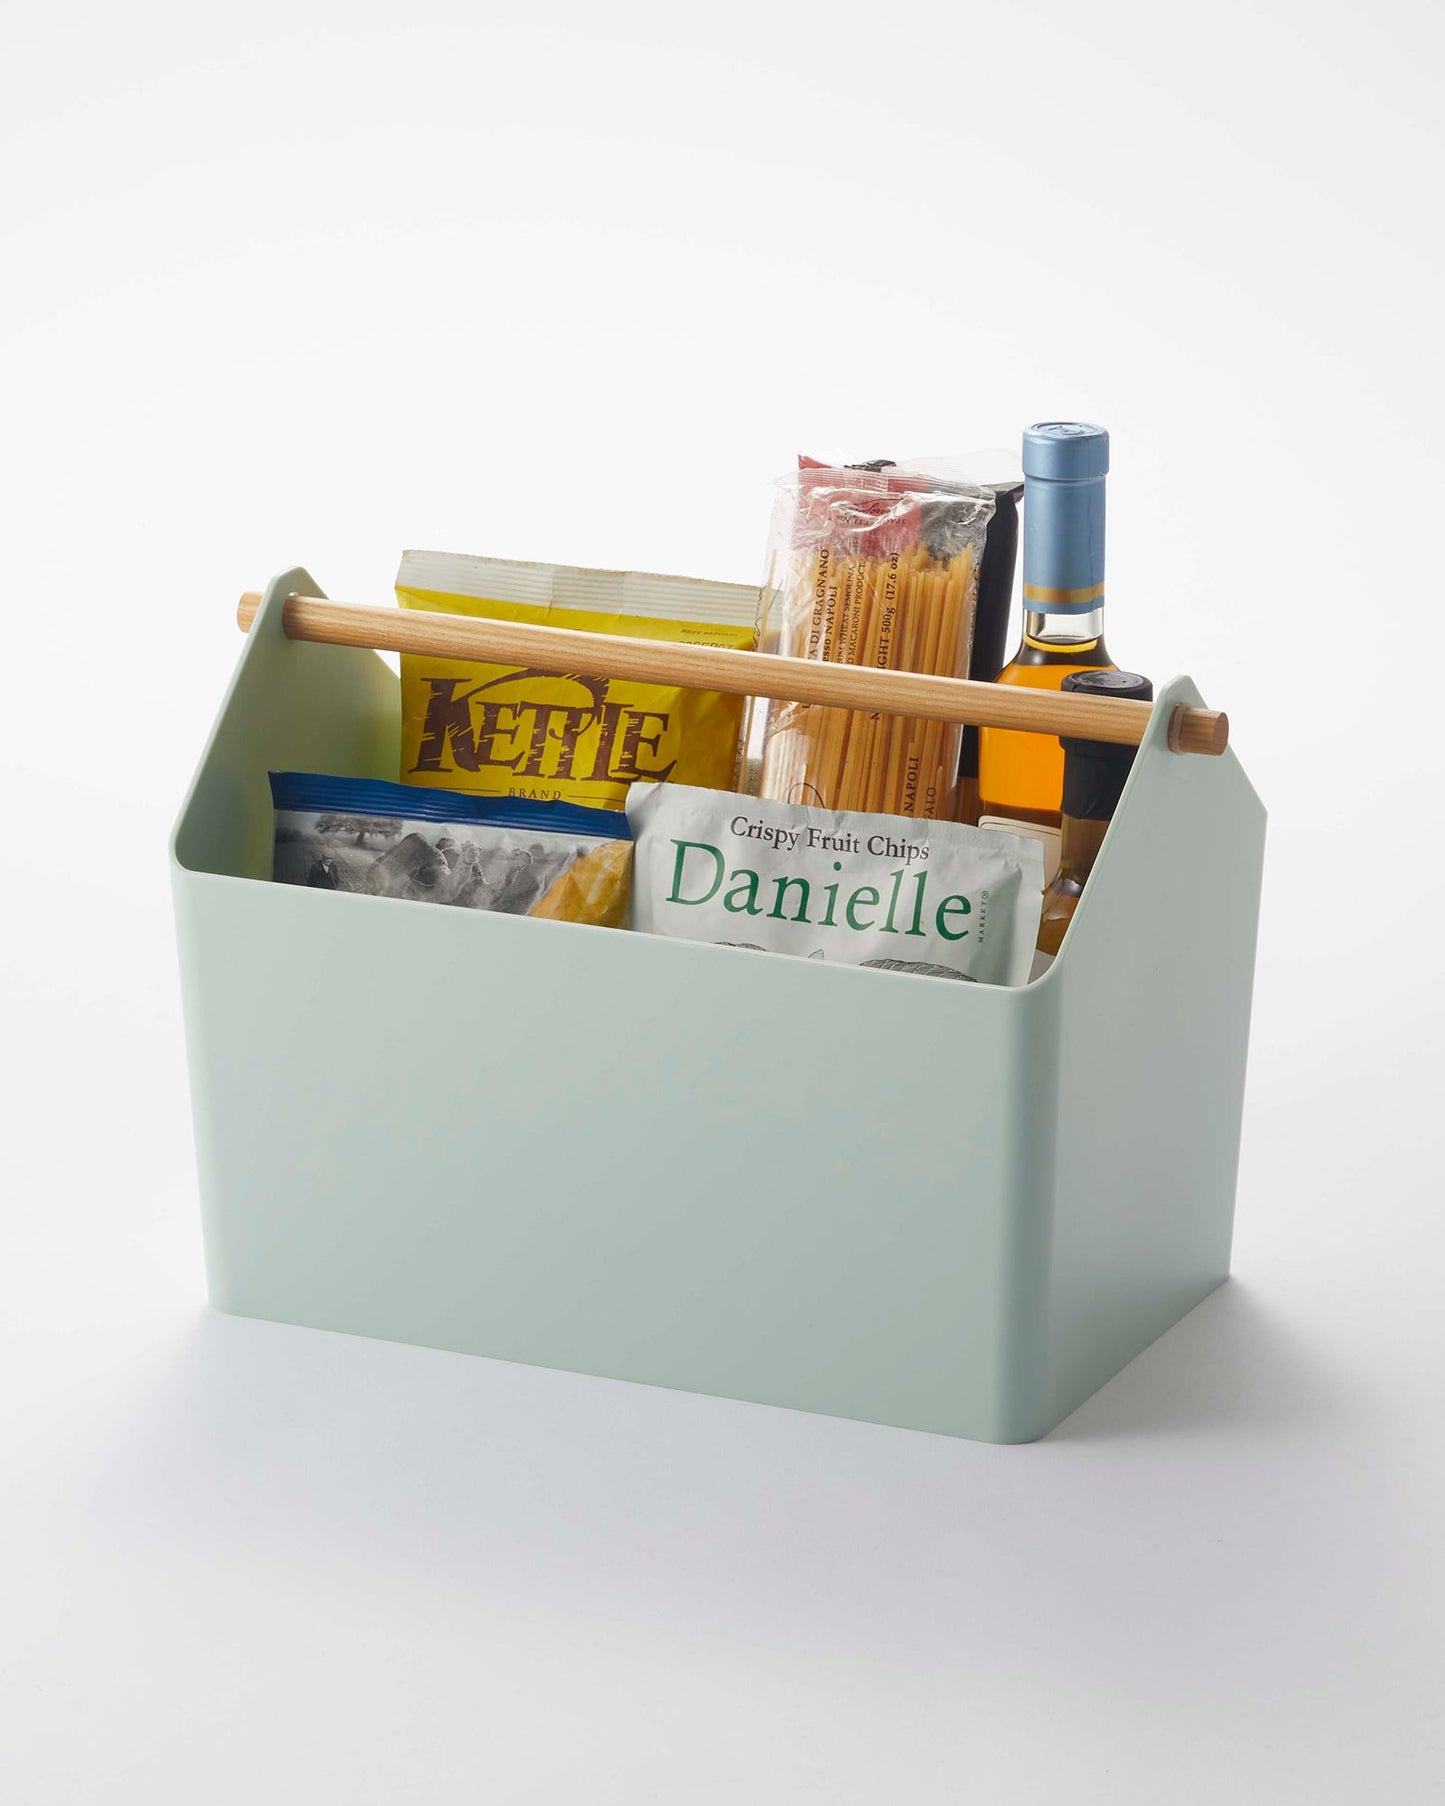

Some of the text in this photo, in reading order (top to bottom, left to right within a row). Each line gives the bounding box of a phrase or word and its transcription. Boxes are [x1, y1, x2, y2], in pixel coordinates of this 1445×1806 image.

[813, 549, 830, 626] GRAGNANO
[822, 585, 838, 662] esso NAPOLI
[849, 609, 861, 656] MACARONI
[855, 563, 867, 604] PRODUCT
[877, 552, 901, 670] IGHT 500g (17.6 oz)
[810, 630, 820, 645] DI
[408, 667, 678, 784] KETTLE
[508, 787, 562, 800] BRAND
[904, 756, 919, 813] NAPOLI
[730, 816, 930, 866] Crispy Fruit Chips
[665, 838, 973, 942] Danielle
